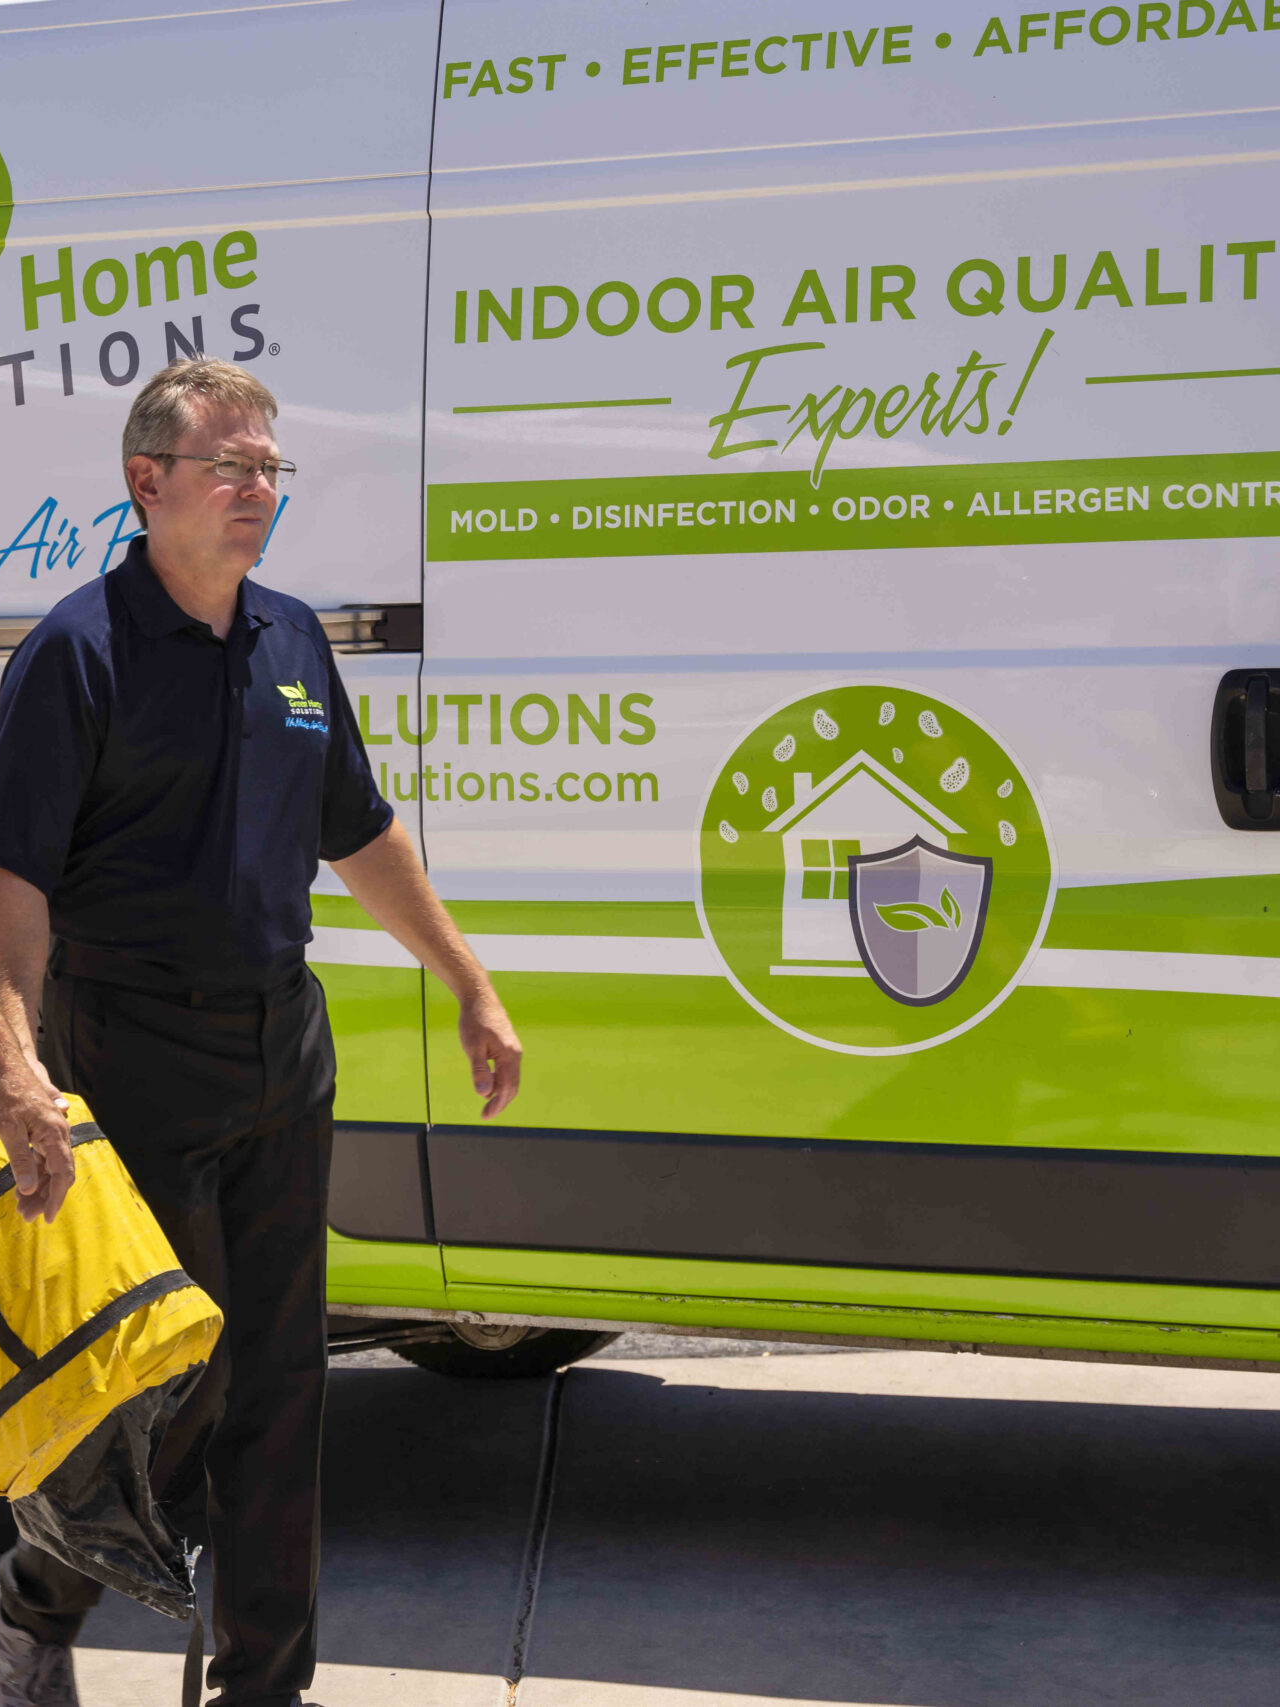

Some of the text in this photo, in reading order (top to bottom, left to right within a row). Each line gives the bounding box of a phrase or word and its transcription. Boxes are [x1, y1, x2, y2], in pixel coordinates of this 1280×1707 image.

[443, 54, 566, 99] FAST
[622, 24, 914, 86] EFFECTIVE
[21, 230, 258, 332] Home
[453, 273, 755, 344] INDOOR
[782, 264, 917, 327] AIR
[707, 328, 1055, 490] Experts!
[450, 508, 538, 534] MOLD
[572, 499, 797, 531] DISINFECTION
[831, 494, 931, 521] ODOR
[967, 485, 1149, 518] ALLERGEN
